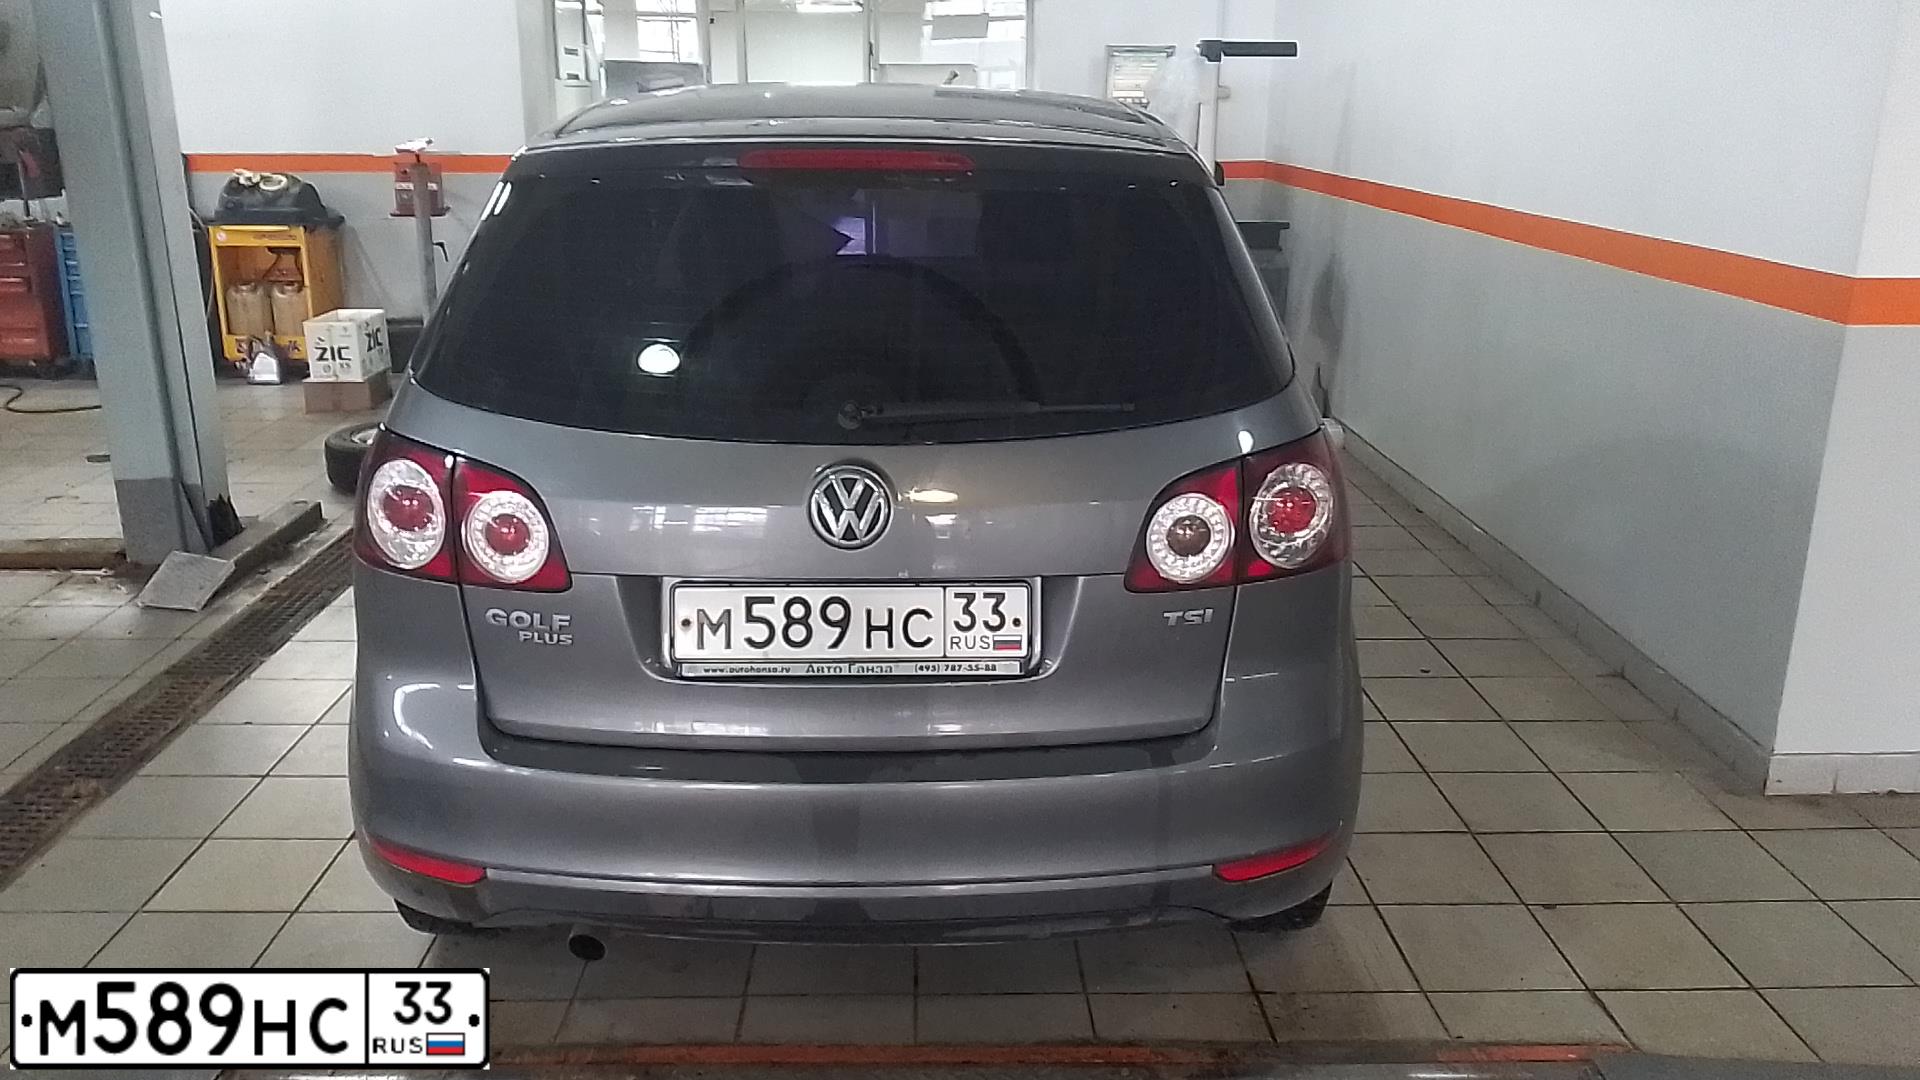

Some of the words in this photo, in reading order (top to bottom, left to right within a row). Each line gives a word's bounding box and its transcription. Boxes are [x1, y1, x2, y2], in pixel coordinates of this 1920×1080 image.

[314, 346, 352, 361] ZIC
[485, 608, 571, 631] GOLF
[953, 592, 1006, 632] 33
[1163, 608, 1214, 626] TSI
[519, 630, 573, 645] PLUS
[950, 635, 990, 650] RUS
[805, 663, 843, 674] Авто
[848, 662, 893, 674] Ганза
